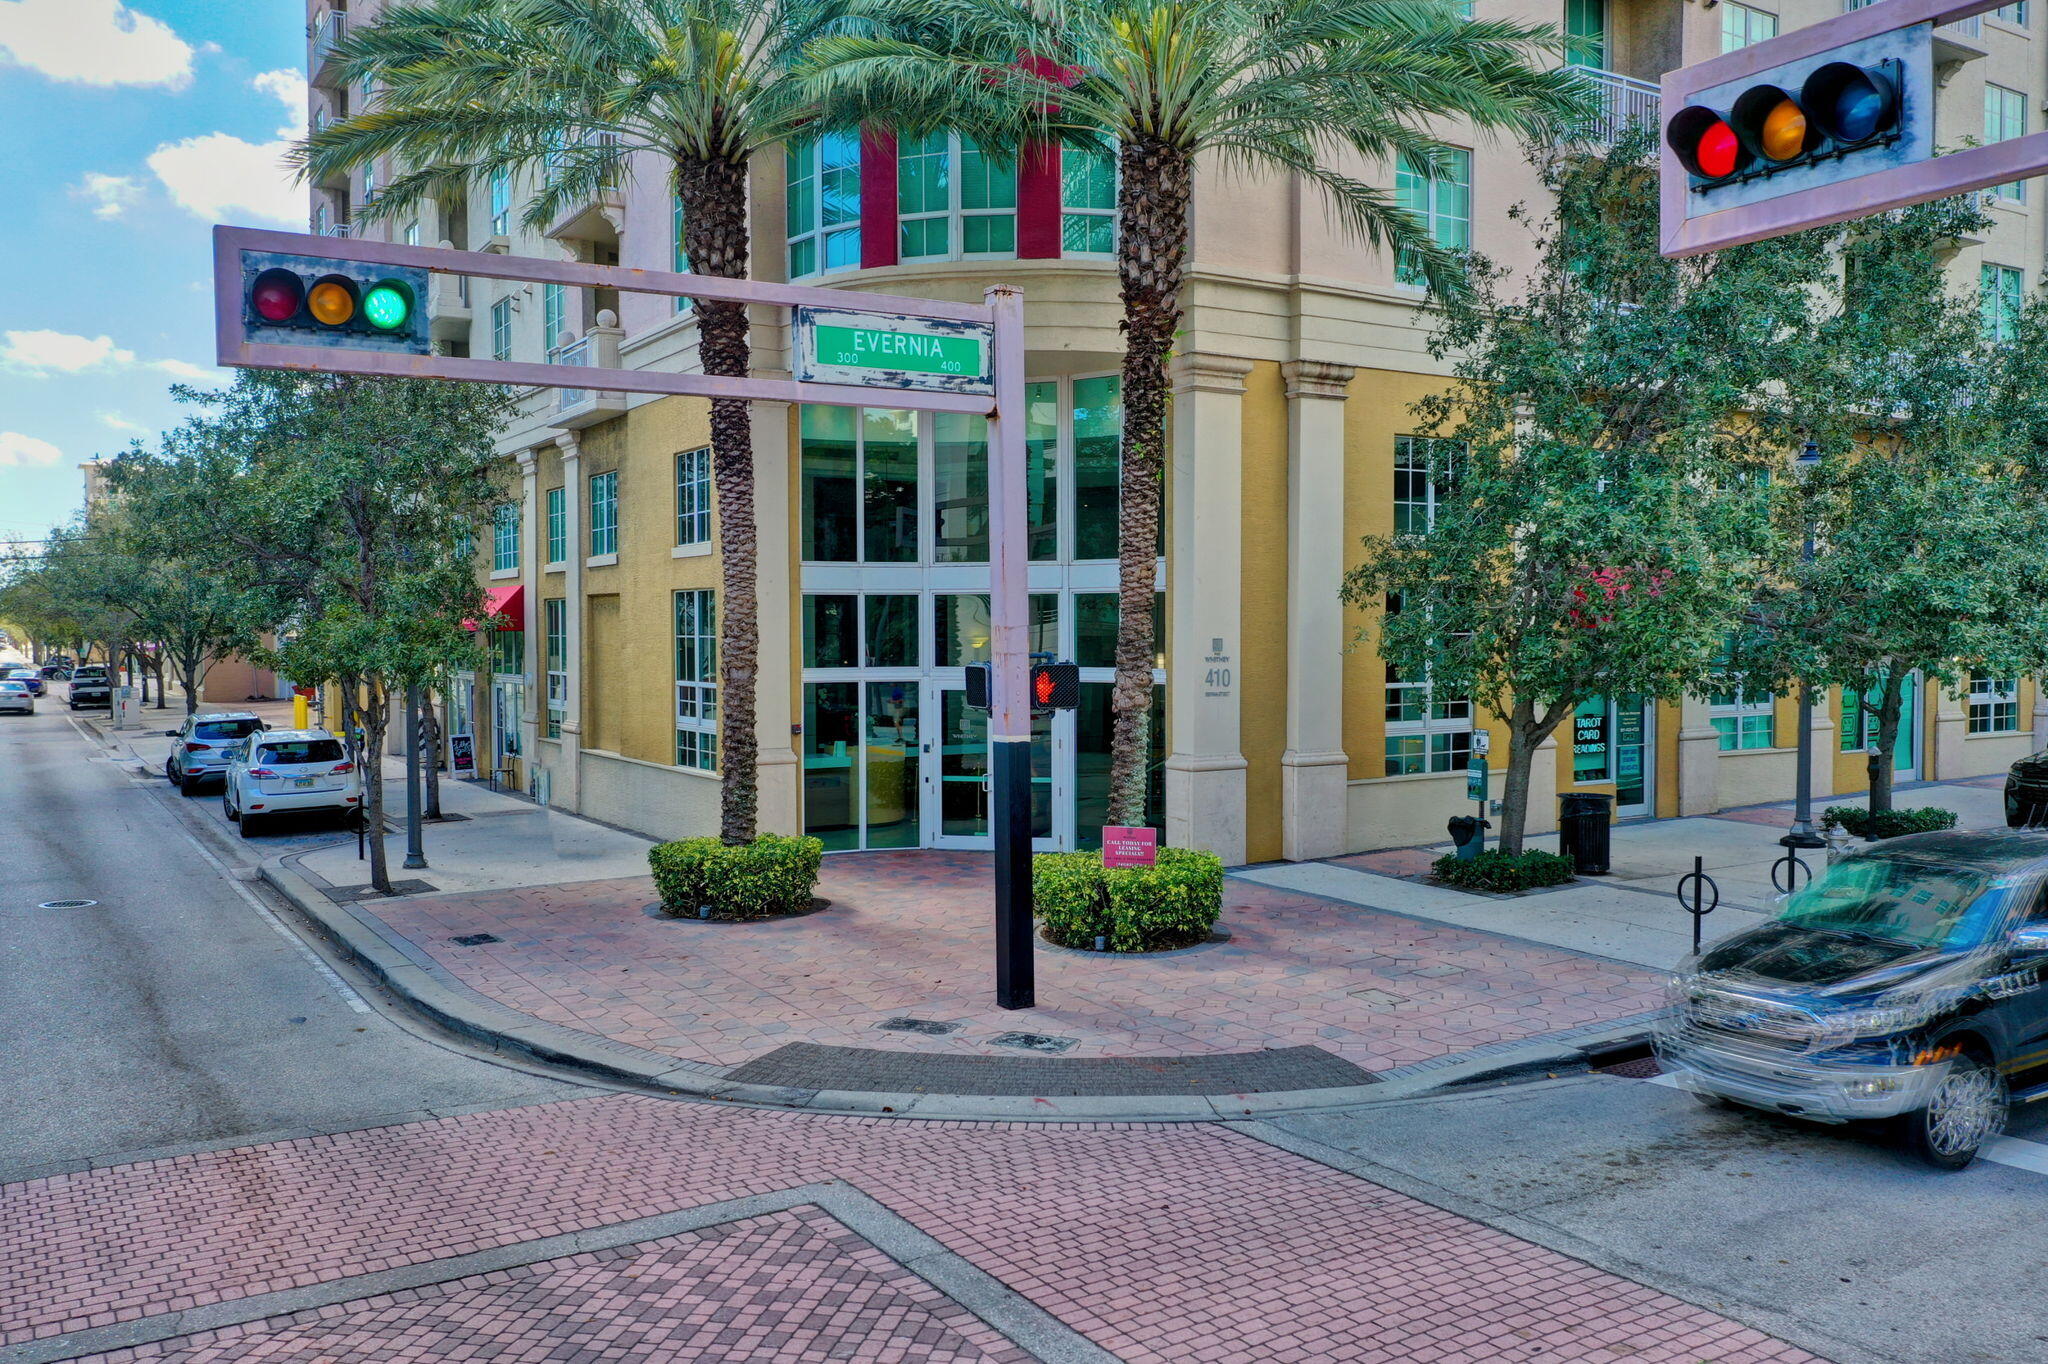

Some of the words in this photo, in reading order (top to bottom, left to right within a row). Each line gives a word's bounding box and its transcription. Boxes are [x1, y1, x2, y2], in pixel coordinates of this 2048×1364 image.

[853, 331, 944, 357] EVERNIA
[837, 352, 859, 364] 300
[940, 360, 961, 372] 400
[1205, 668, 1231, 687] 410
[1576, 718, 1602, 728] TAROT
[1577, 730, 1600, 741] CARD
[1573, 743, 1605, 754] READINGS
